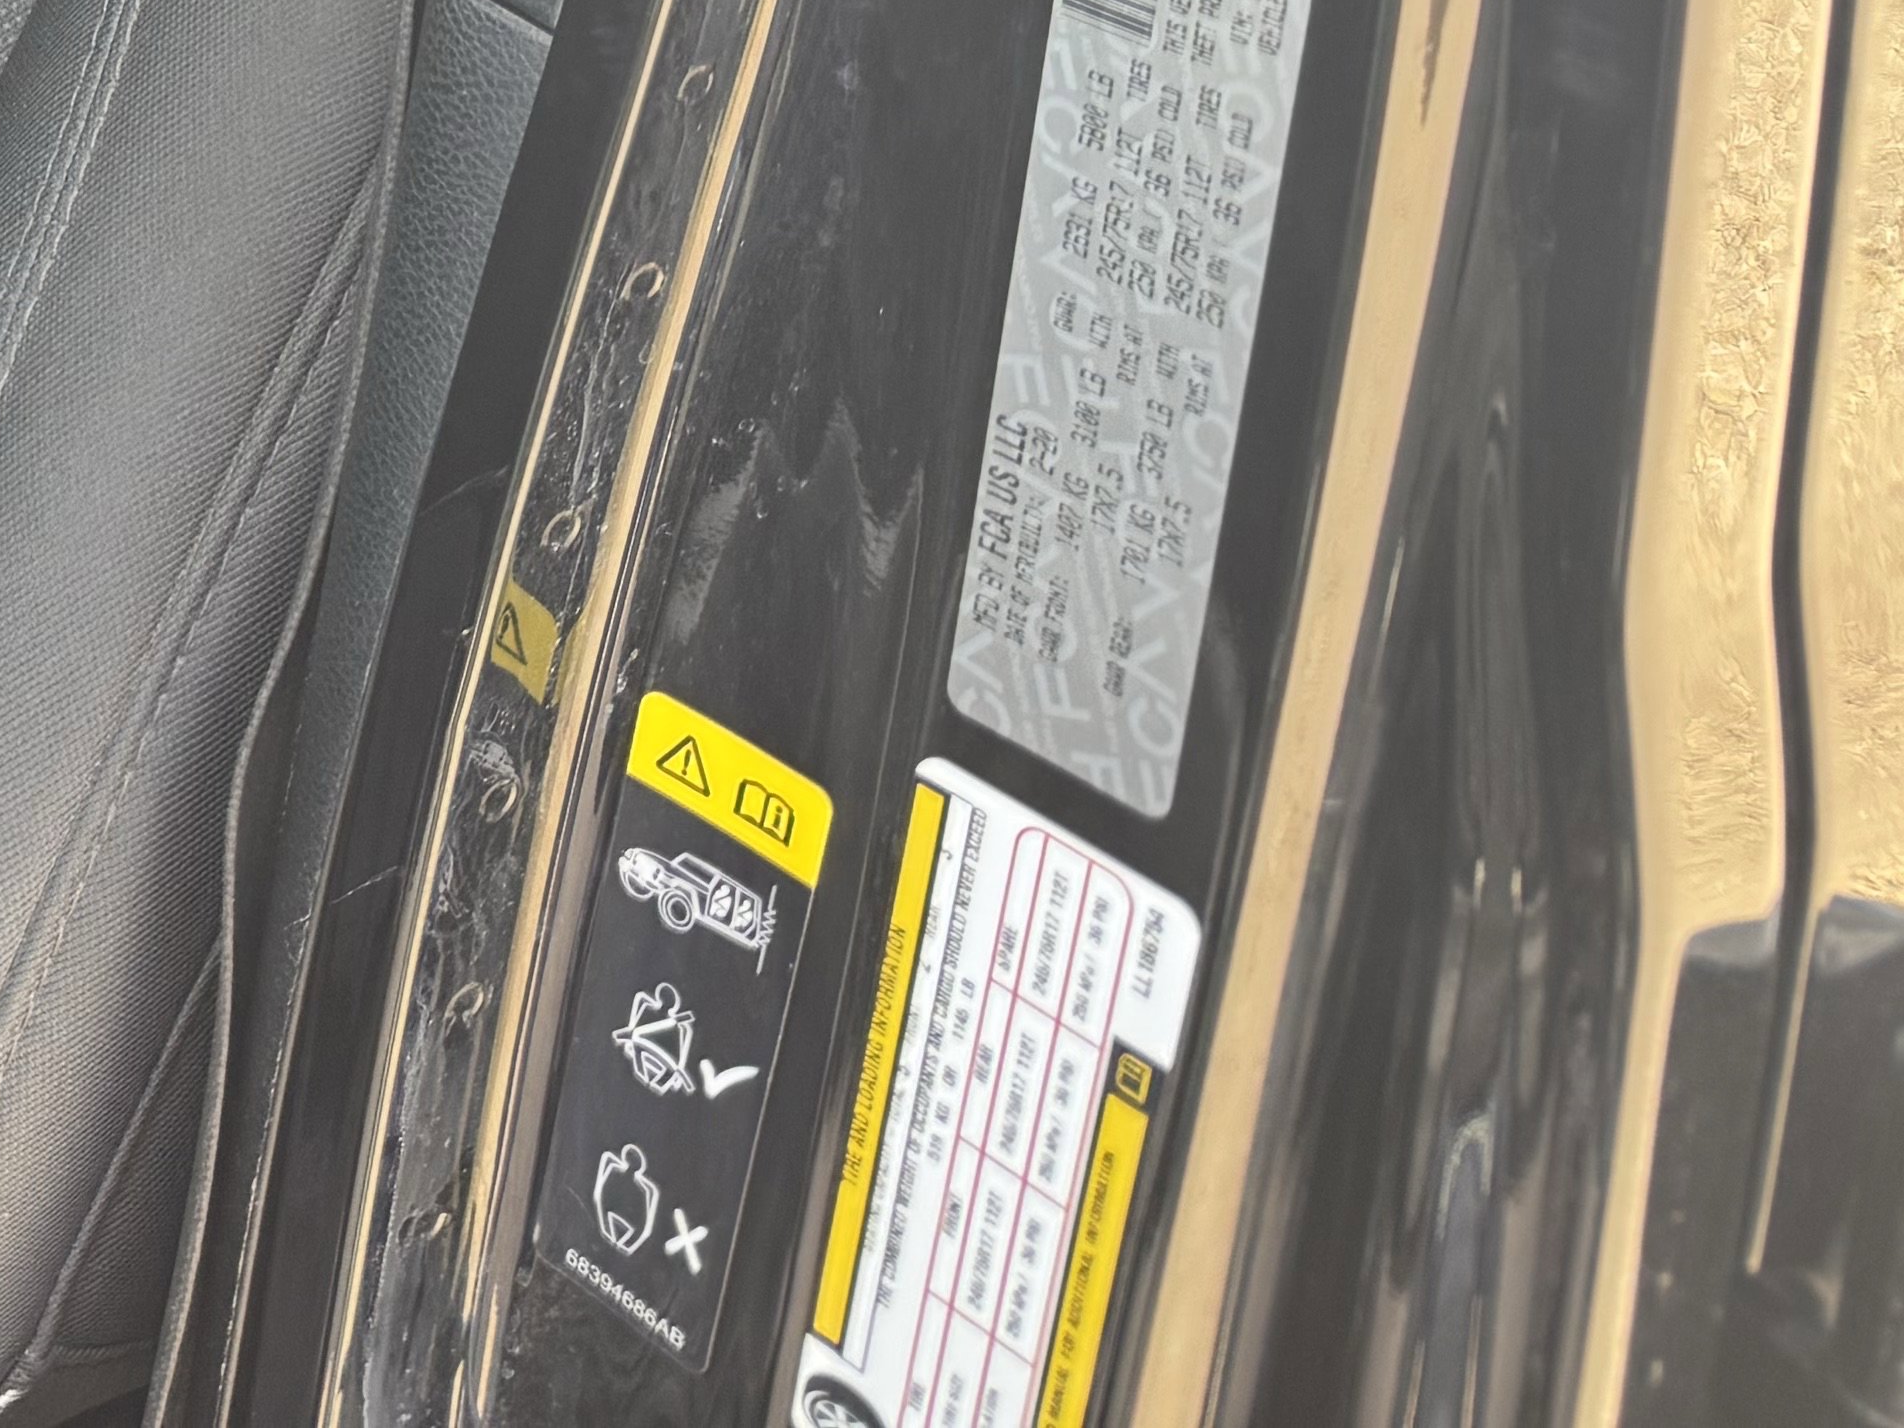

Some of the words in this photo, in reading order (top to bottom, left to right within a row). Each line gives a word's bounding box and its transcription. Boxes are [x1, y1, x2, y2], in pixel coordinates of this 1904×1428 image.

[1162, 18, 1187, 57] THIS
[1190, 20, 1218, 68] THEFT
[1087, 68, 1114, 98] LB
[1126, 56, 1152, 103] TIRES
[1157, 83, 1182, 123] COLD
[1195, 83, 1222, 132] TIRES
[1078, 101, 1109, 153] 5800
[1227, 110, 1253, 152] COLD
[1112, 125, 1144, 177] 112T
[1070, 174, 1097, 206] KG
[1143, 167, 1172, 198] 36
[1180, 153, 1213, 206] 112T
[1095, 179, 1135, 285] 245/75R17
[1212, 195, 1242, 227] 36
[1062, 207, 1092, 260] 2631
[1127, 256, 1157, 299] 250
[1163, 207, 1204, 315] 245/75R17
[1088, 309, 1113, 350] WITH
[1195, 285, 1227, 330] 250
[1123, 322, 1143, 347] AT
[1078, 366, 1106, 398] LB
[1116, 346, 1140, 387] RIMS
[1155, 340, 1180, 382] WITH
[1145, 397, 1173, 429] LB
[1184, 377, 1209, 419] RIMS
[992, 411, 1028, 467] LLC
[1069, 397, 1101, 450] 3100
[1028, 424, 1059, 477] 2-20
[1136, 428, 1168, 482] 3750
[986, 462, 1020, 508] US
[1062, 469, 1089, 502] KG
[978, 501, 1014, 561] FCA
[1054, 501, 1084, 552] 1407
[1127, 501, 1156, 534] KG
[977, 559, 1004, 593] BY
[1119, 533, 1151, 586] 1701
[971, 590, 1000, 633] MFD
[1009, 584, 1030, 609] OF
[1004, 607, 1027, 647] DATE
[963, 805, 988, 863] EXCEED
[954, 861, 977, 912] NEVER
[942, 910, 967, 970] SHOULD
[997, 923, 1018, 973] SPARE
[869, 921, 907, 1038] INFORMATION
[932, 967, 955, 1020] CARGO
[959, 976, 975, 999] LB
[926, 1018, 945, 1052] AND
[951, 1004, 969, 1041] 1145
[855, 1035, 884, 1112] LOADING
[973, 1042, 994, 1085] REAR
[909, 1049, 939, 1134] OCCUPANTS
[934, 1100, 950, 1125] KG
[848, 1109, 869, 1149] AND
[906, 1133, 922, 1155] OF
[894, 1153, 918, 1210] WEIGHT
[880, 1207, 908, 1282] COMBINED
[565, 1248, 687, 1352] 68394686AB
[875, 1281, 893, 1310] THE
